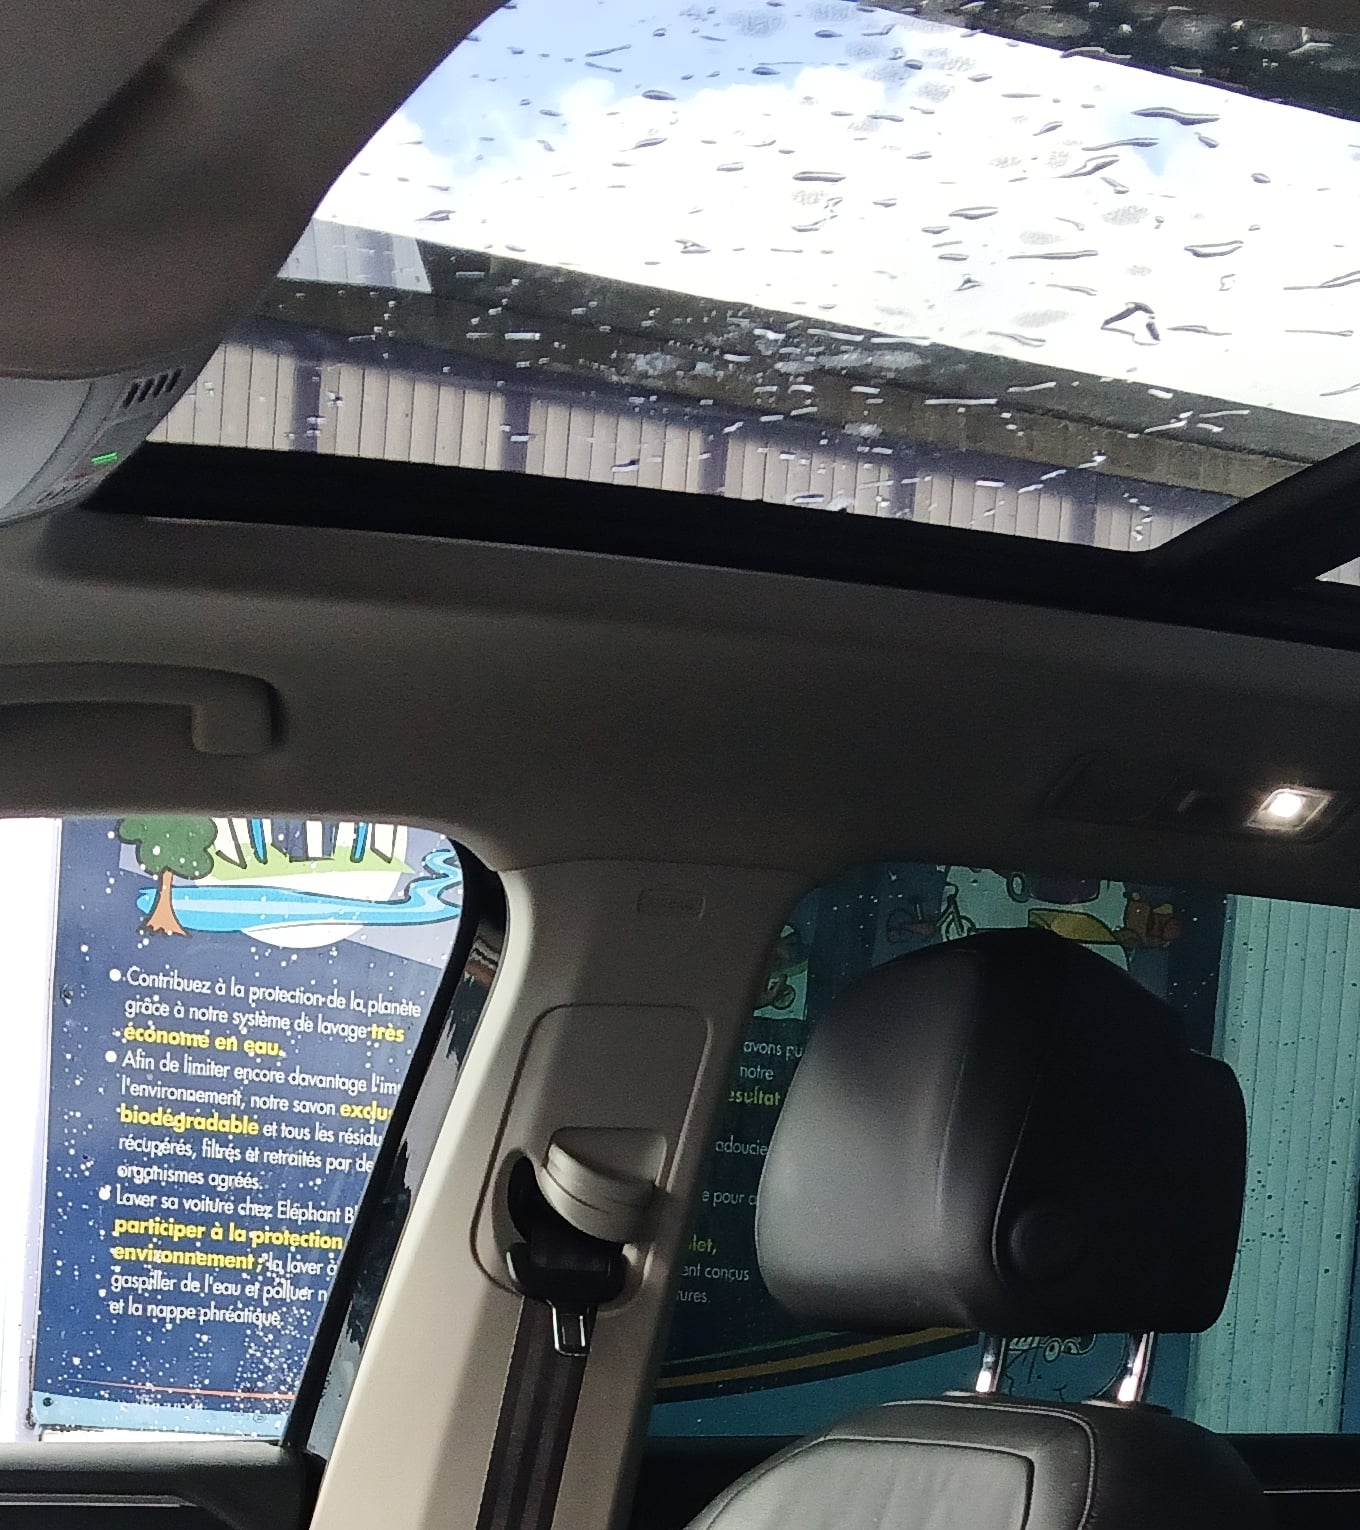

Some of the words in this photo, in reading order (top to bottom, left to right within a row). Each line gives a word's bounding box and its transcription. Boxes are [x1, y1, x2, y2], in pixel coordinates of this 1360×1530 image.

[127, 966, 211, 995] Contribuez
[215, 977, 226, 995] à
[231, 978, 244, 998] la
[249, 981, 324, 1007] protection
[327, 988, 346, 1009] de
[350, 989, 364, 1011] la
[368, 993, 422, 1017] planète
[125, 997, 170, 1018] grâce
[174, 1001, 185, 1018] à
[189, 1004, 229, 1023] notre
[233, 1009, 290, 1032] système
[294, 1011, 313, 1032] de
[318, 1015, 367, 1042] lavage
[371, 1022, 405, 1042] très
[124, 1025, 210, 1049] économe
[215, 1035, 238, 1052] en
[244, 1040, 285, 1057] eau.
[743, 1041, 782, 1056] avons
[122, 1050, 154, 1070] Afin
[159, 1053, 180, 1074] de
[184, 1055, 230, 1078] limiter
[234, 1063, 285, 1084] encore
[289, 1065, 368, 1096] davantage
[740, 1065, 774, 1080] notre
[121, 1075, 245, 1110] l'environnement,
[250, 1093, 289, 1112] notre
[293, 1097, 336, 1116] savon
[120, 1103, 259, 1135] biodégradable
[263, 1120, 278, 1137] et
[281, 1122, 311, 1141] tous
[315, 1121, 334, 1142] les
[119, 1135, 196, 1159] récupérés,
[202, 1137, 241, 1163] filtrés
[245, 1146, 260, 1163] et
[263, 1147, 322, 1168] retraités
[325, 1156, 353, 1174] par
[117, 1163, 204, 1187] organismes
[209, 1171, 263, 1191] agréés.
[116, 1184, 156, 1209] Laver
[161, 1196, 179, 1209] sa
[183, 1194, 234, 1215] voiture
[238, 1196, 273, 1219] chez
[713, 1192, 745, 1207] pour
[114, 1217, 206, 1241] participer
[211, 1221, 223, 1240] à
[229, 1222, 246, 1243] la
[251, 1228, 343, 1250] protection
[688, 1234, 717, 1255] let,
[268, 1251, 283, 1272] la
[287, 1253, 324, 1275] laver
[704, 1267, 750, 1283] conçus
[111, 1268, 178, 1293] gaspiller
[181, 1273, 201, 1293] de
[205, 1276, 242, 1297] l'eau
[245, 1281, 260, 1299] et
[263, 1279, 315, 1306] polluer
[109, 1298, 126, 1315] et
[128, 1296, 143, 1315] la
[147, 1303, 196, 1324] nappe
